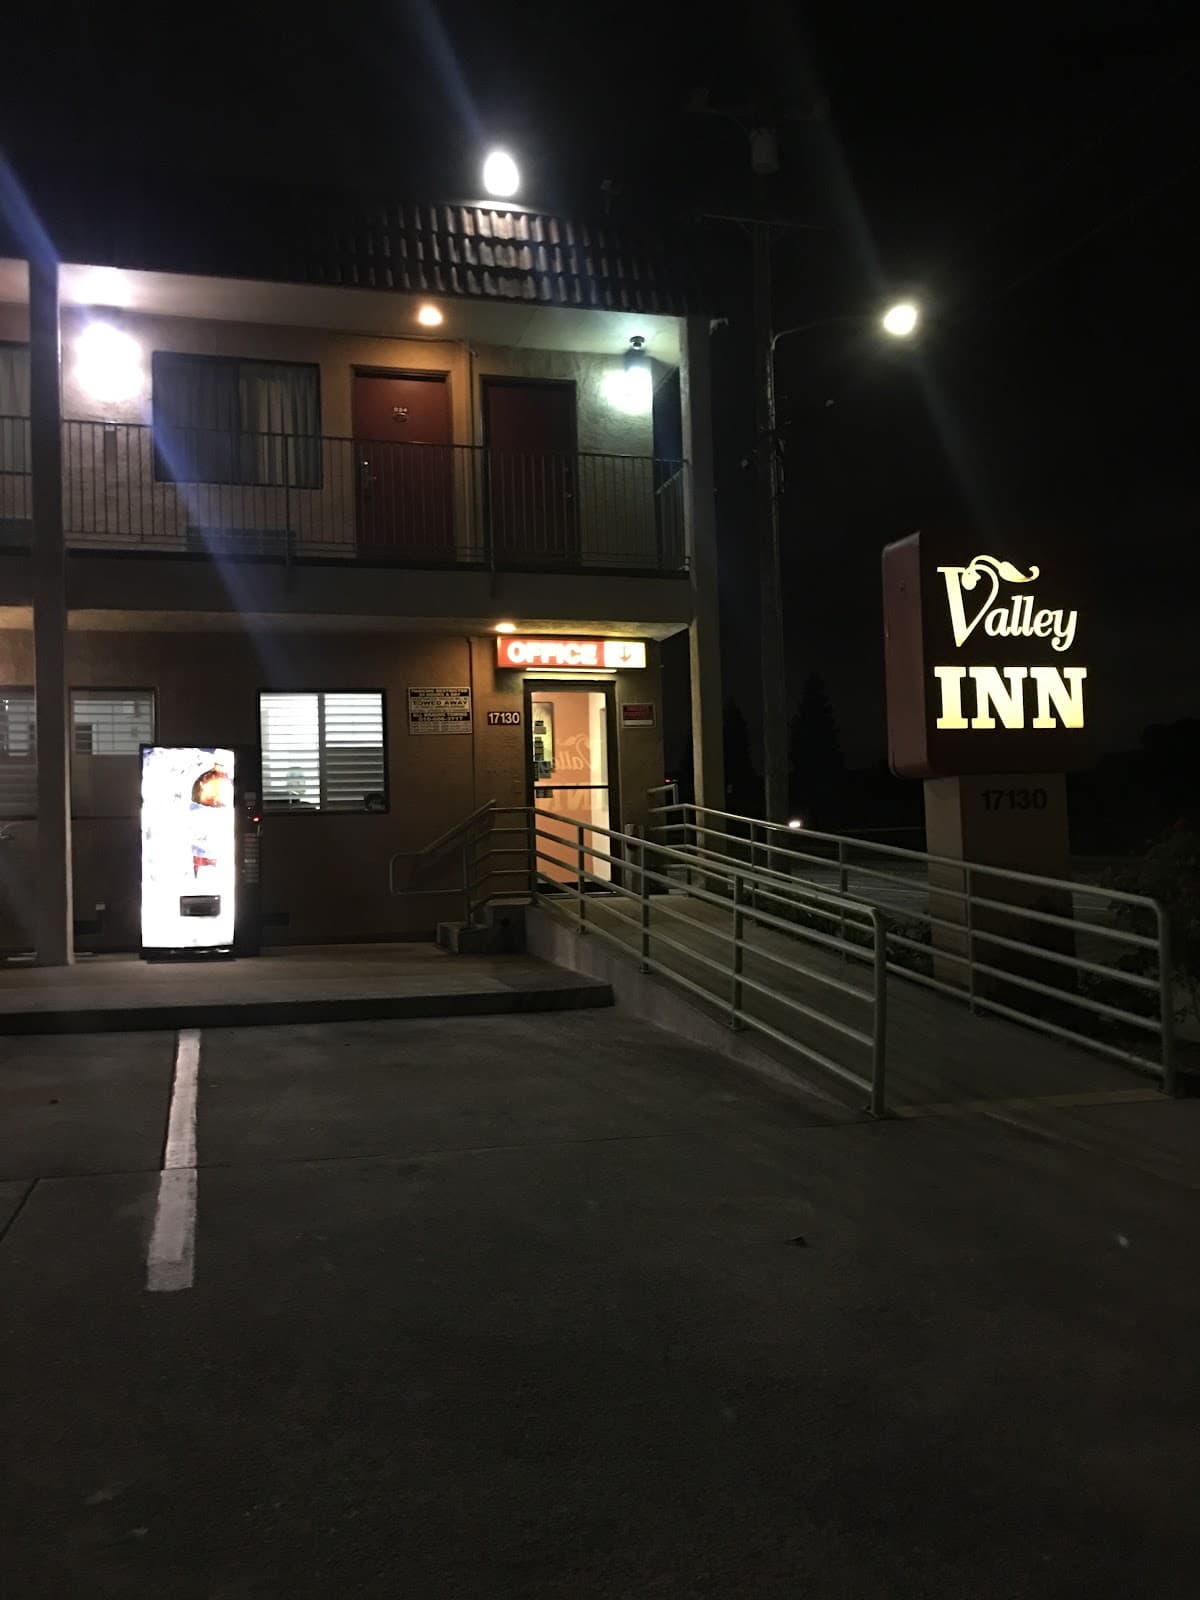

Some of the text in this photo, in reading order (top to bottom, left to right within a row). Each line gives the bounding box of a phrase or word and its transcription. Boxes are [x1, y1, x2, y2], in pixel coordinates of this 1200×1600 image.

[936, 553, 1078, 652] Valley
[507, 641, 597, 665] OFFICE
[934, 666, 1088, 730] INN
[488, 712, 520, 724] 17130
[981, 788, 1048, 810] 17130
